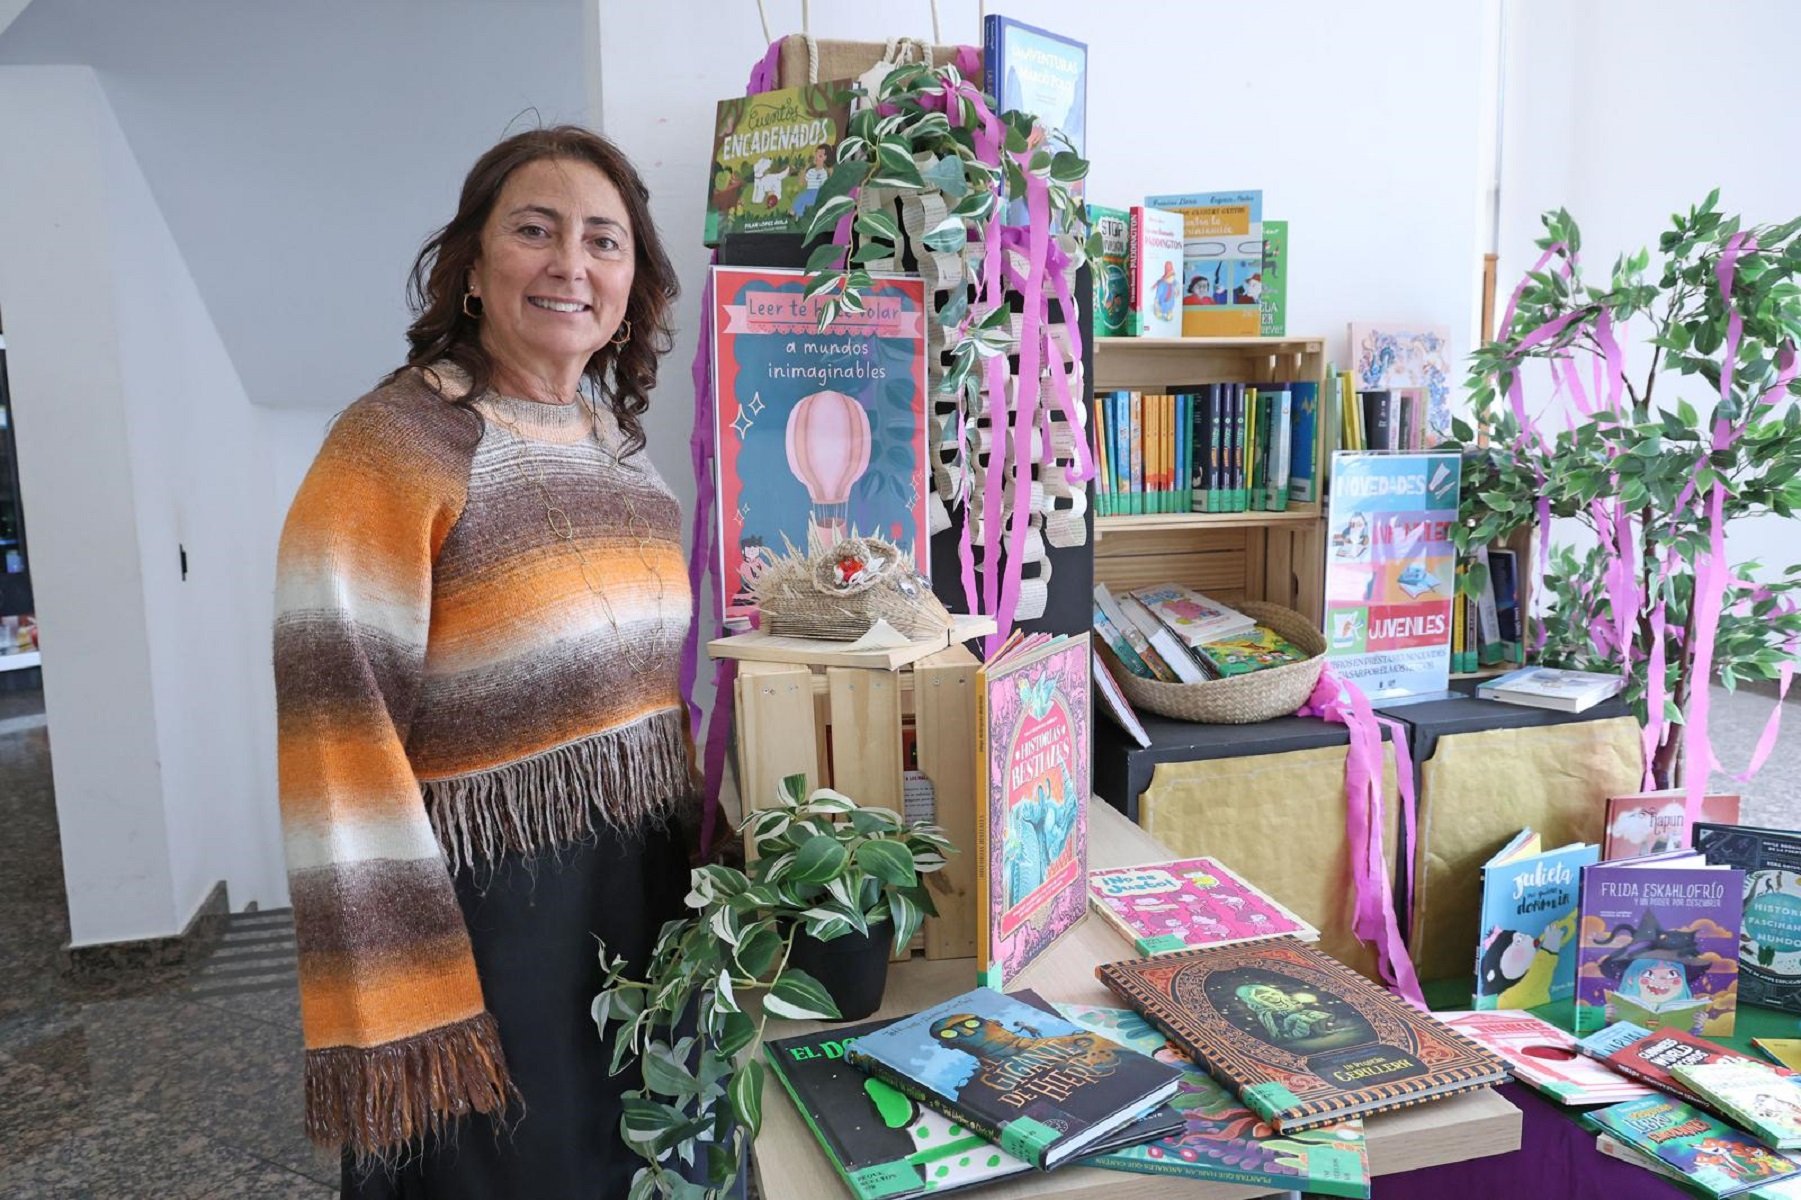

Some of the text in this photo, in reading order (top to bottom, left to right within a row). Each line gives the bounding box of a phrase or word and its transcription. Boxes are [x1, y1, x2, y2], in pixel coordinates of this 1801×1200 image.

[749, 98, 801, 131] Cuentos
[723, 118, 828, 160] ENCADENADOS
[1145, 236, 1182, 250] PADDINGTON
[749, 293, 899, 320] Leer te hce volar
[786, 338, 868, 355] a mundos
[768, 362, 886, 386] inimaginables
[1336, 475, 1426, 497] NOVEDADES
[1368, 614, 1445, 640] JUVENILES
[1020, 724, 1061, 761] HISTORIAS
[1012, 735, 1070, 792] BESTIALES
[1107, 879, 1177, 894] Justo!
[1601, 880, 1724, 899] FRIDA ESKAHLOFRÍO
[1517, 888, 1570, 915] dormir
[1754, 903, 1801, 917] HISTOR
[790, 1046, 823, 1060] EL
[1651, 1045, 1693, 1066] WORLD
[981, 1040, 1083, 1091] GIGANTE
[997, 1089, 1038, 1108] DE
[1235, 1173, 1272, 1184] PLANTAS
